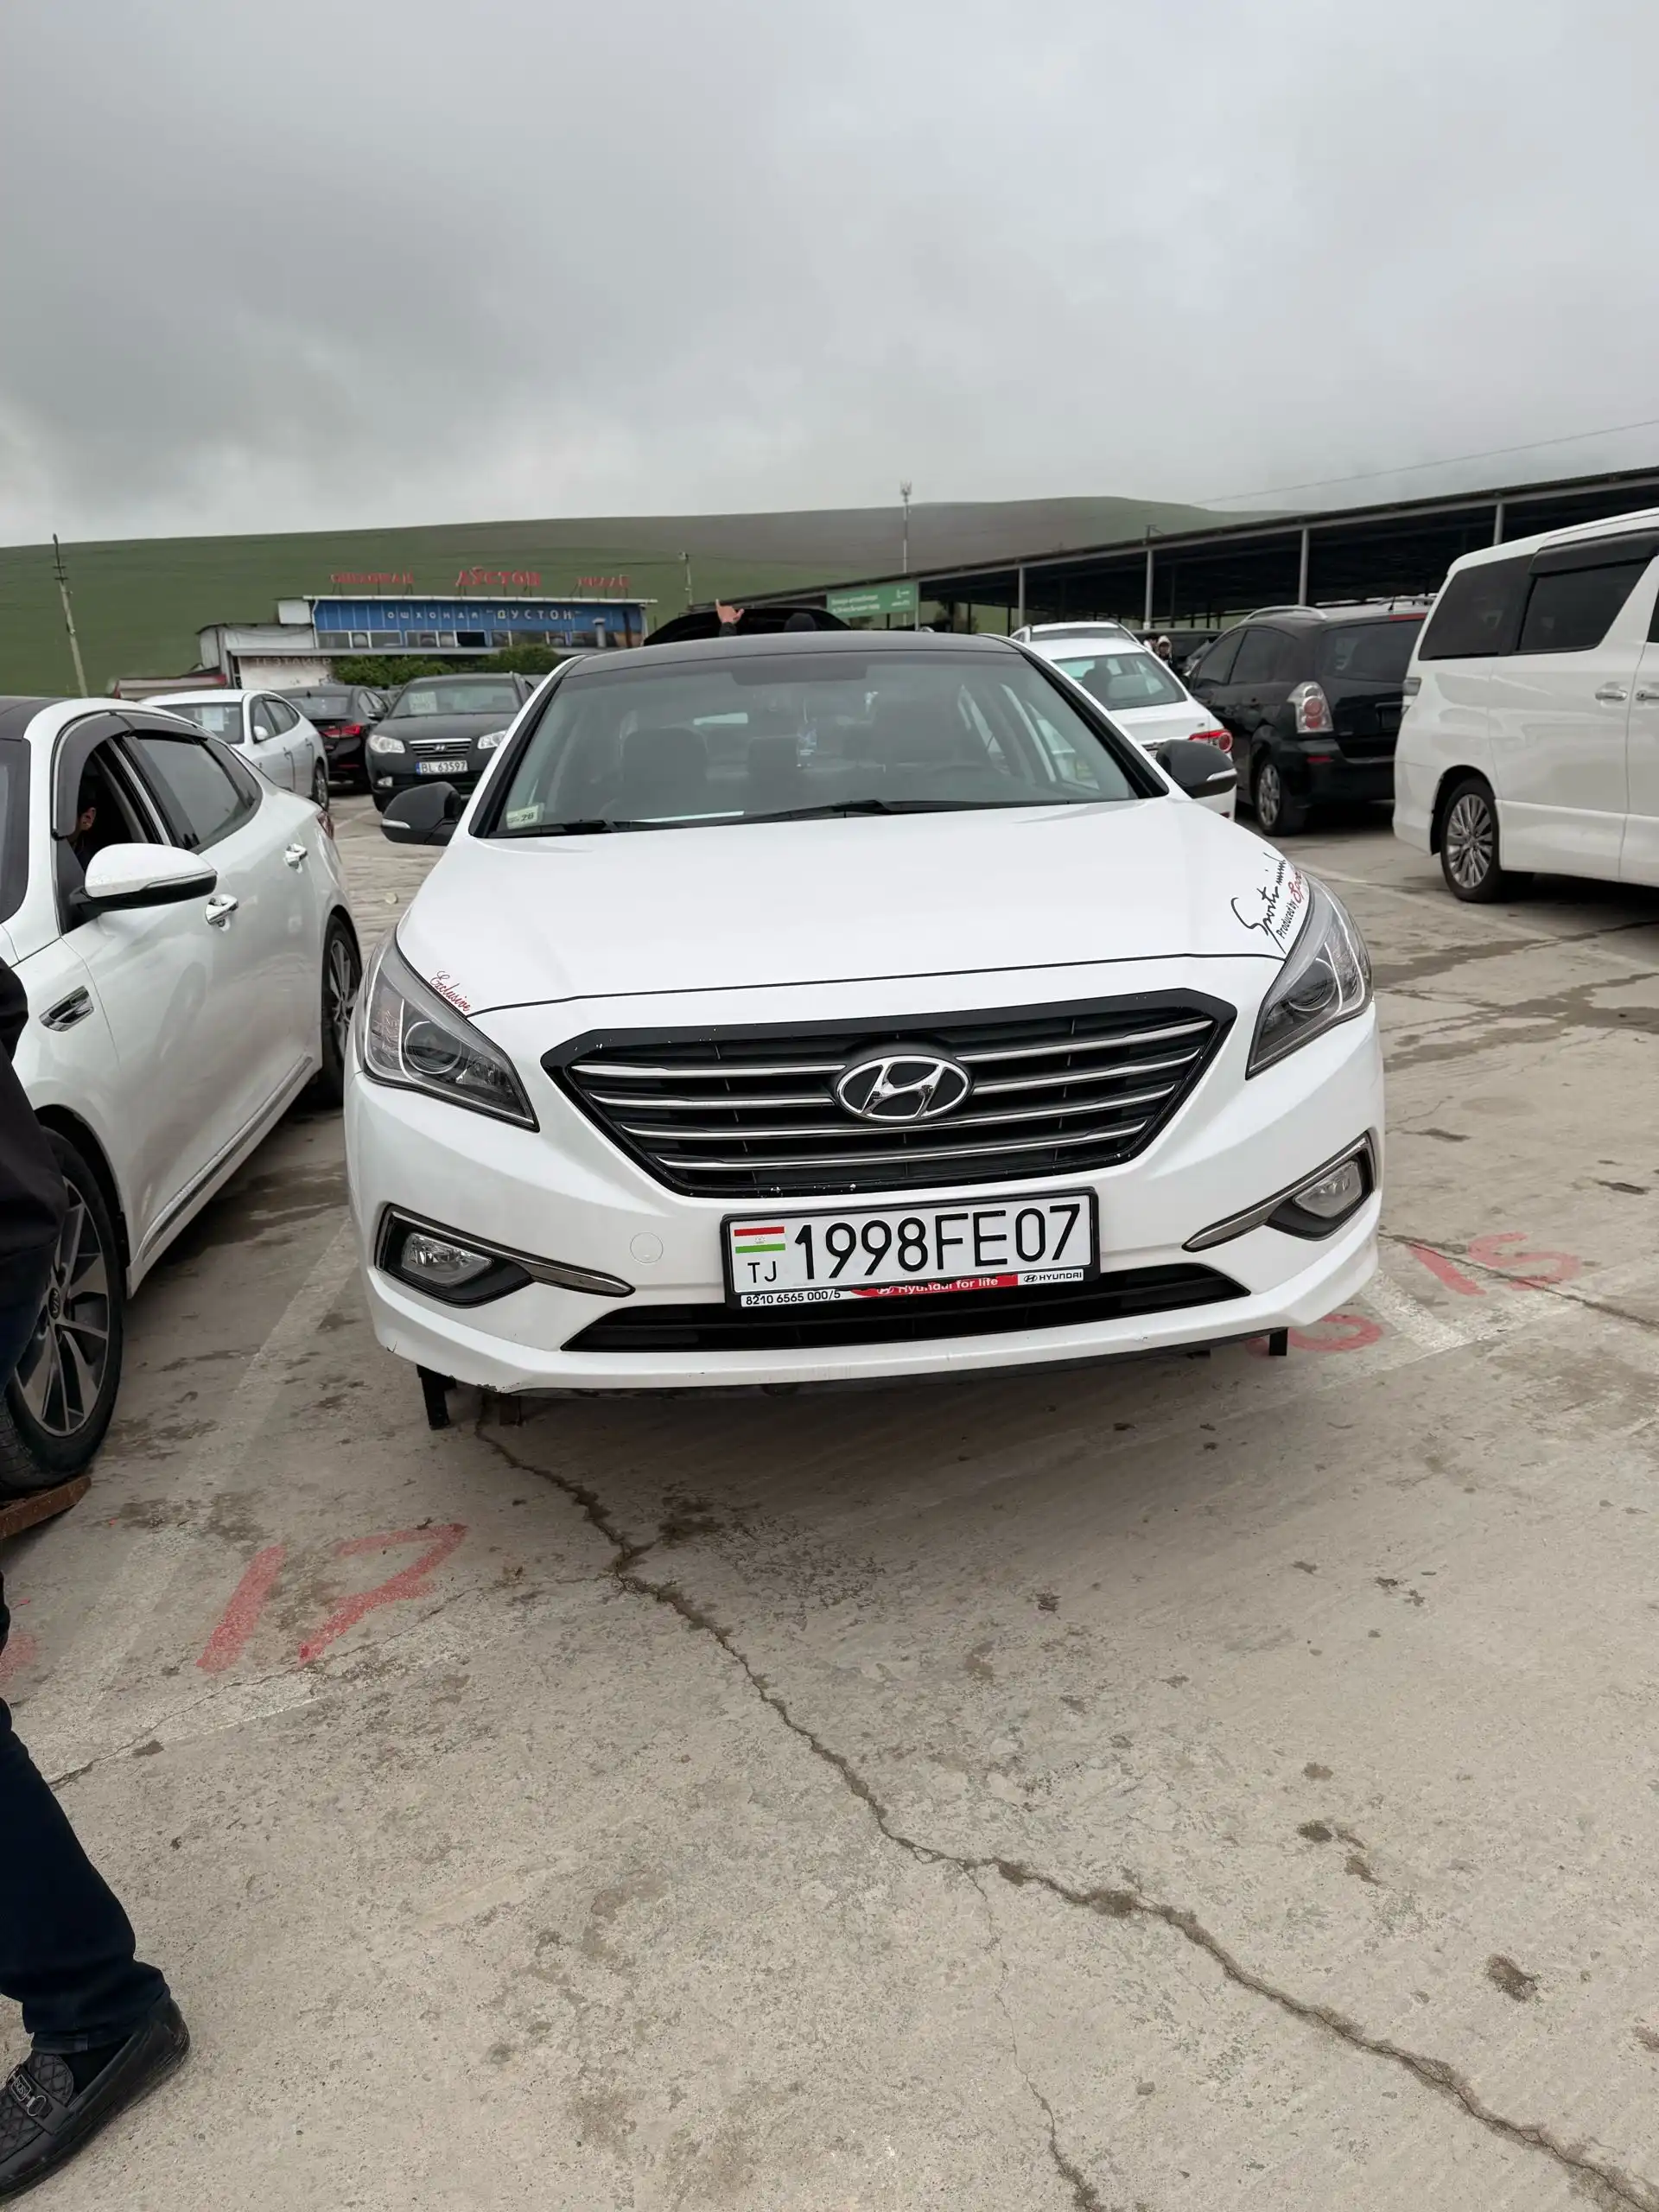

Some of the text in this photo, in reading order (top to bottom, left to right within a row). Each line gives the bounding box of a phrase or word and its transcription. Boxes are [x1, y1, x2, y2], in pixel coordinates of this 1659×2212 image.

[430, 970, 471, 1012] Exclusive
[795, 1203, 1082, 1281] 1998FE07
[747, 1261, 778, 1284] TJ
[1039, 1271, 1083, 1281] HYUNDAI
[957, 1280, 975, 1289] for
[978, 1277, 998, 1287] life
[746, 1289, 841, 1306] 8210 6565 000/5
